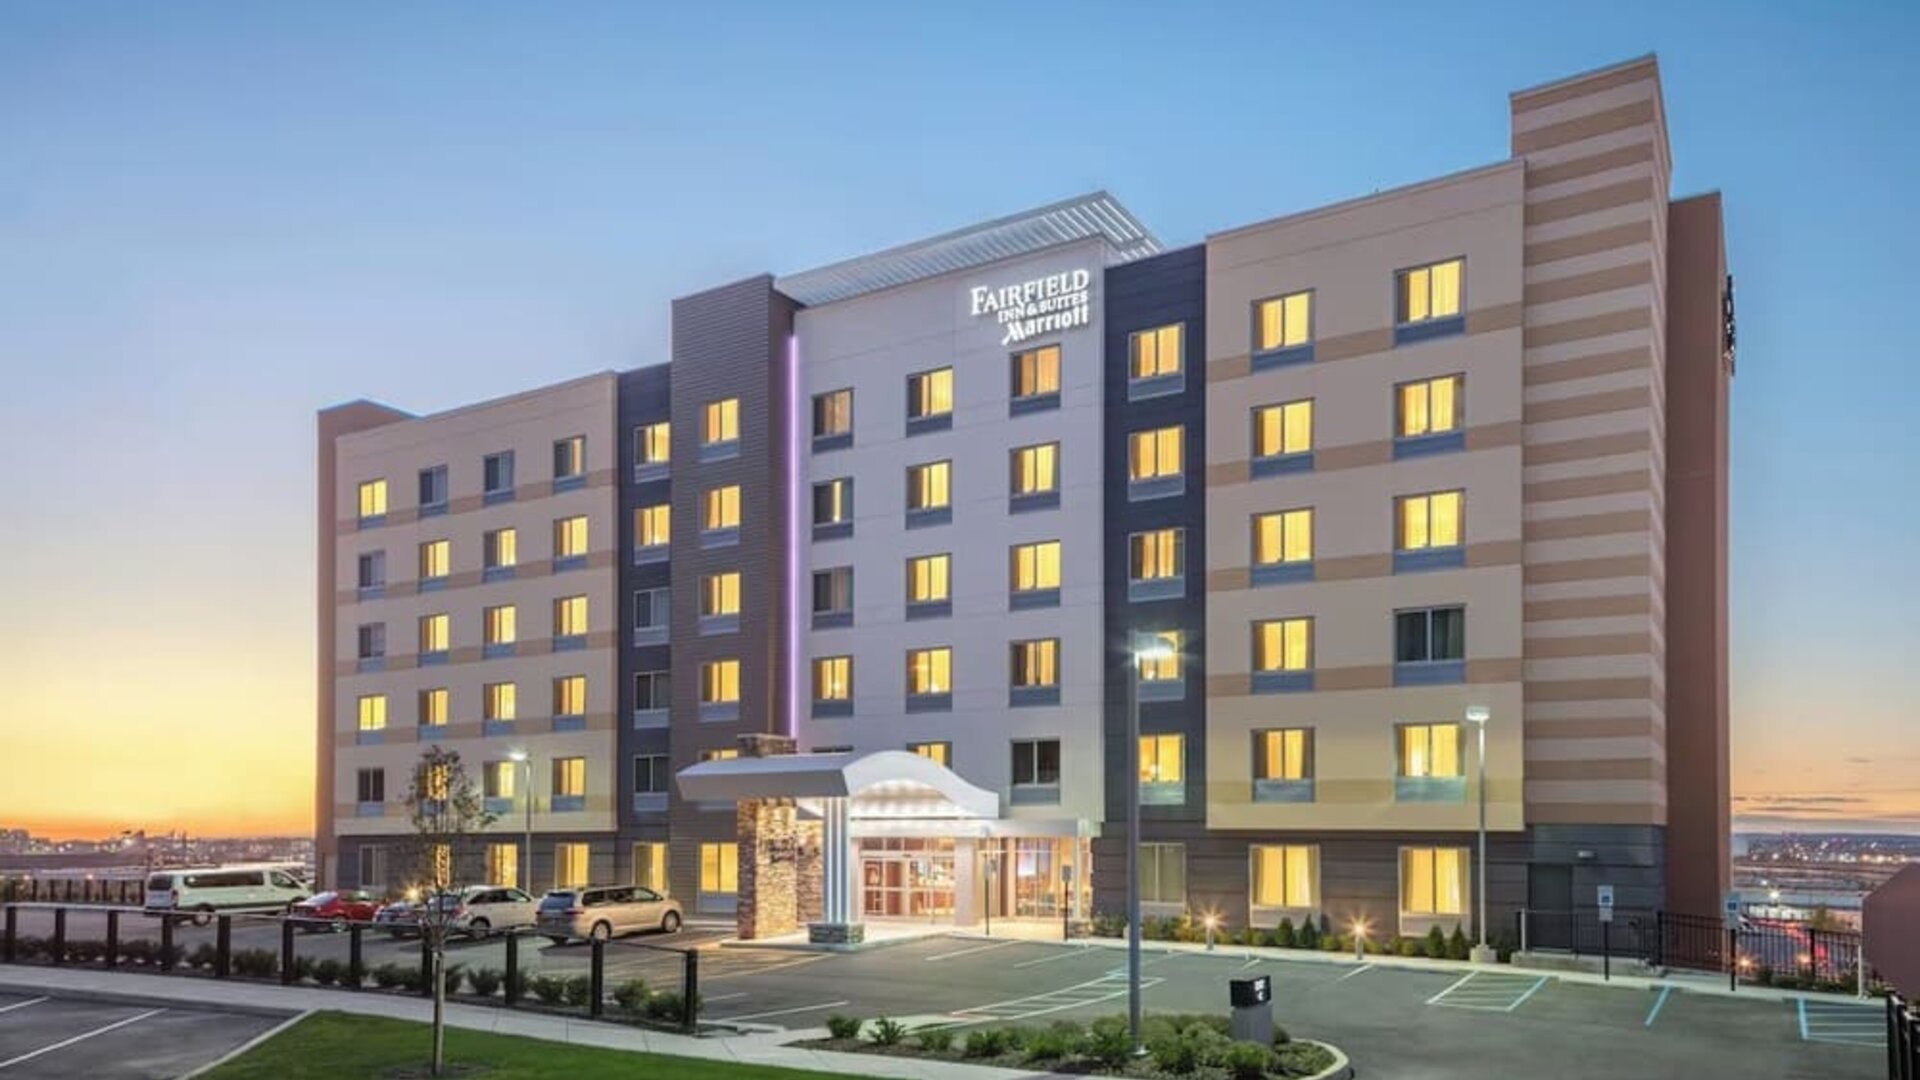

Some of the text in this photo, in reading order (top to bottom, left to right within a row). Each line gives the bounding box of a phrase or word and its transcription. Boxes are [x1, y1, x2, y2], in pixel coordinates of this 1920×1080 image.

[970, 269, 1089, 316] FAIRFIELD
[998, 290, 1088, 324] INN & SUITES
[1002, 304, 1088, 346] Marriott
